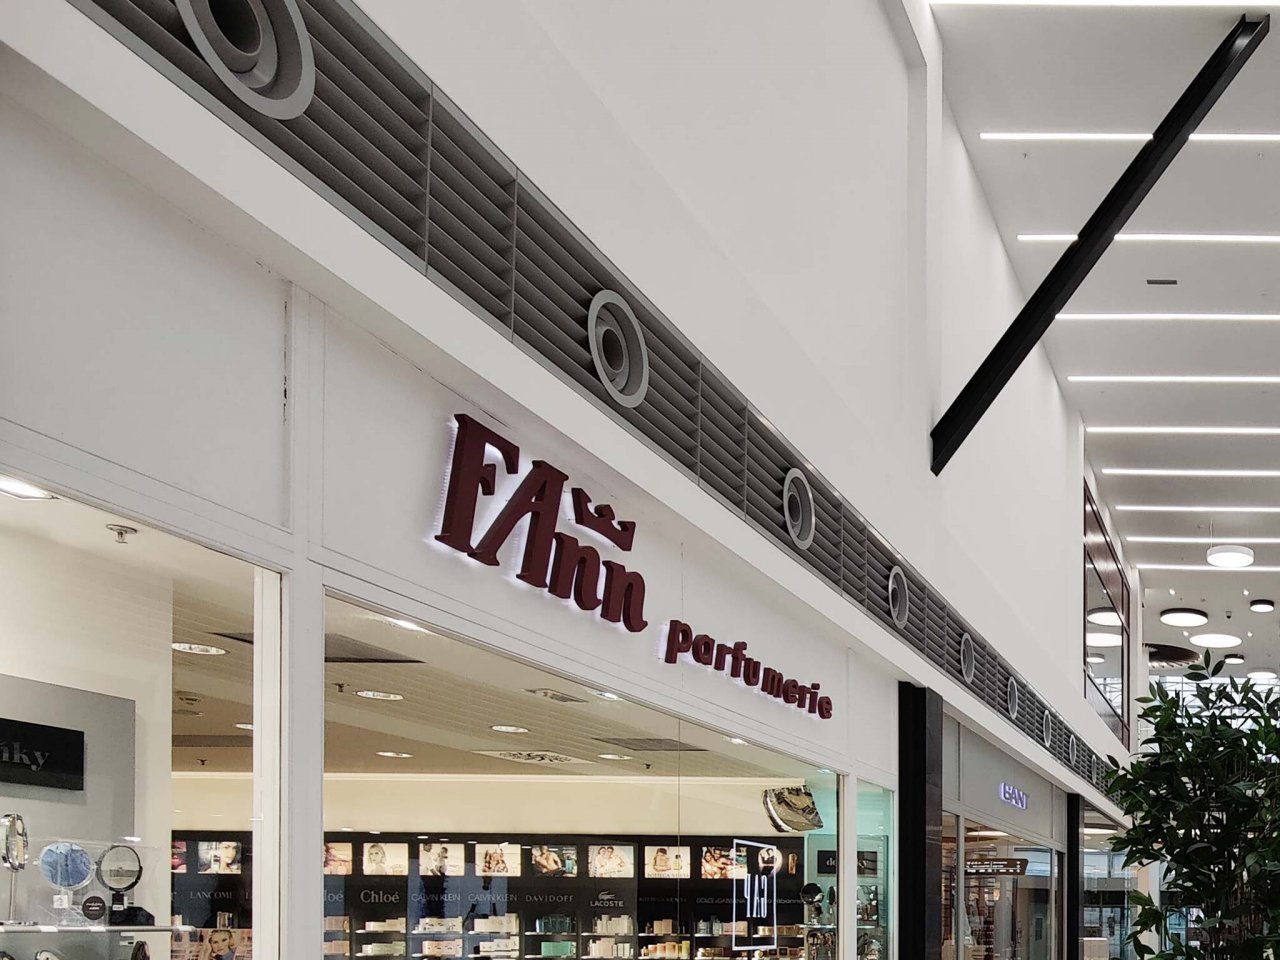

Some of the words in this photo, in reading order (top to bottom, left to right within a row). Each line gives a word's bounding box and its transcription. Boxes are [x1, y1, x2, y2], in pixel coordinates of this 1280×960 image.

[665, 619, 833, 719] parfumerie
[360, 890, 400, 903] Chloé
[525, 895, 574, 903] DAVIDOFF
